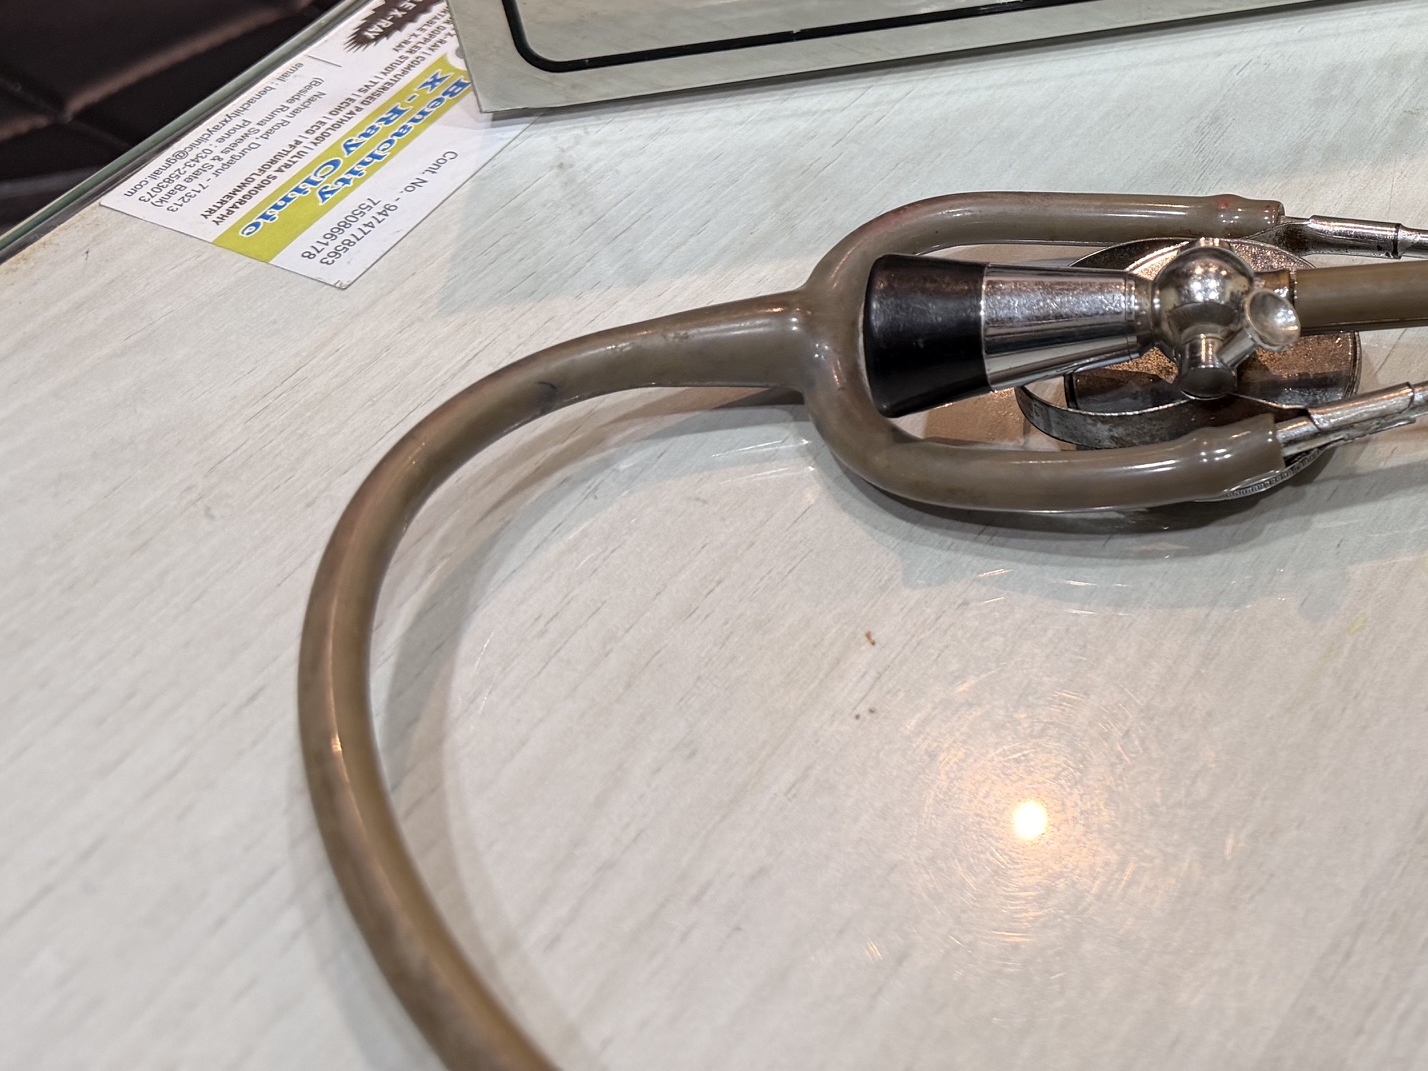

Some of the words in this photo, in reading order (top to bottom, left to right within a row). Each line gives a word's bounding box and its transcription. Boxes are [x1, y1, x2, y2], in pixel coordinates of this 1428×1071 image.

[404, 24, 447, 55] DOPPLER
[274, 61, 304, 83] email
[379, 53, 410, 77] STUDY
[284, 76, 325, 104] (Beside
[356, 79, 380, 94] TVS
[358, 54, 426, 106] COMPUTERISED
[417, 69, 451, 91] X
[255, 103, 291, 127] Ruma
[284, 90, 327, 119] Nachan
[327, 96, 357, 116] ECHO
[214, 117, 253, 144] Phone
[254, 117, 291, 141] Road,
[303, 119, 328, 136] ECG
[309, 104, 364, 147] PATHOLOGY
[341, 105, 407, 156] Ray
[219, 126, 261, 155] Sweets
[316, 78, 470, 203] Benachity
[208, 154, 224, 162] &
[210, 140, 262, 178] Durgapur
[272, 149, 309, 173] ULTRA
[420, 149, 459, 175] Cont.
[137, 147, 214, 203] 0343-2583073
[182, 161, 215, 184] State
[399, 176, 429, 194] No.
[149, 182, 188, 208] Bank)
[165, 182, 209, 213] 713213
[211, 173, 278, 226] SONOGRAPHY
[242, 158, 341, 236] Clinic
[299, 196, 382, 260] 7550866178
[318, 202, 399, 266] 9474778563
